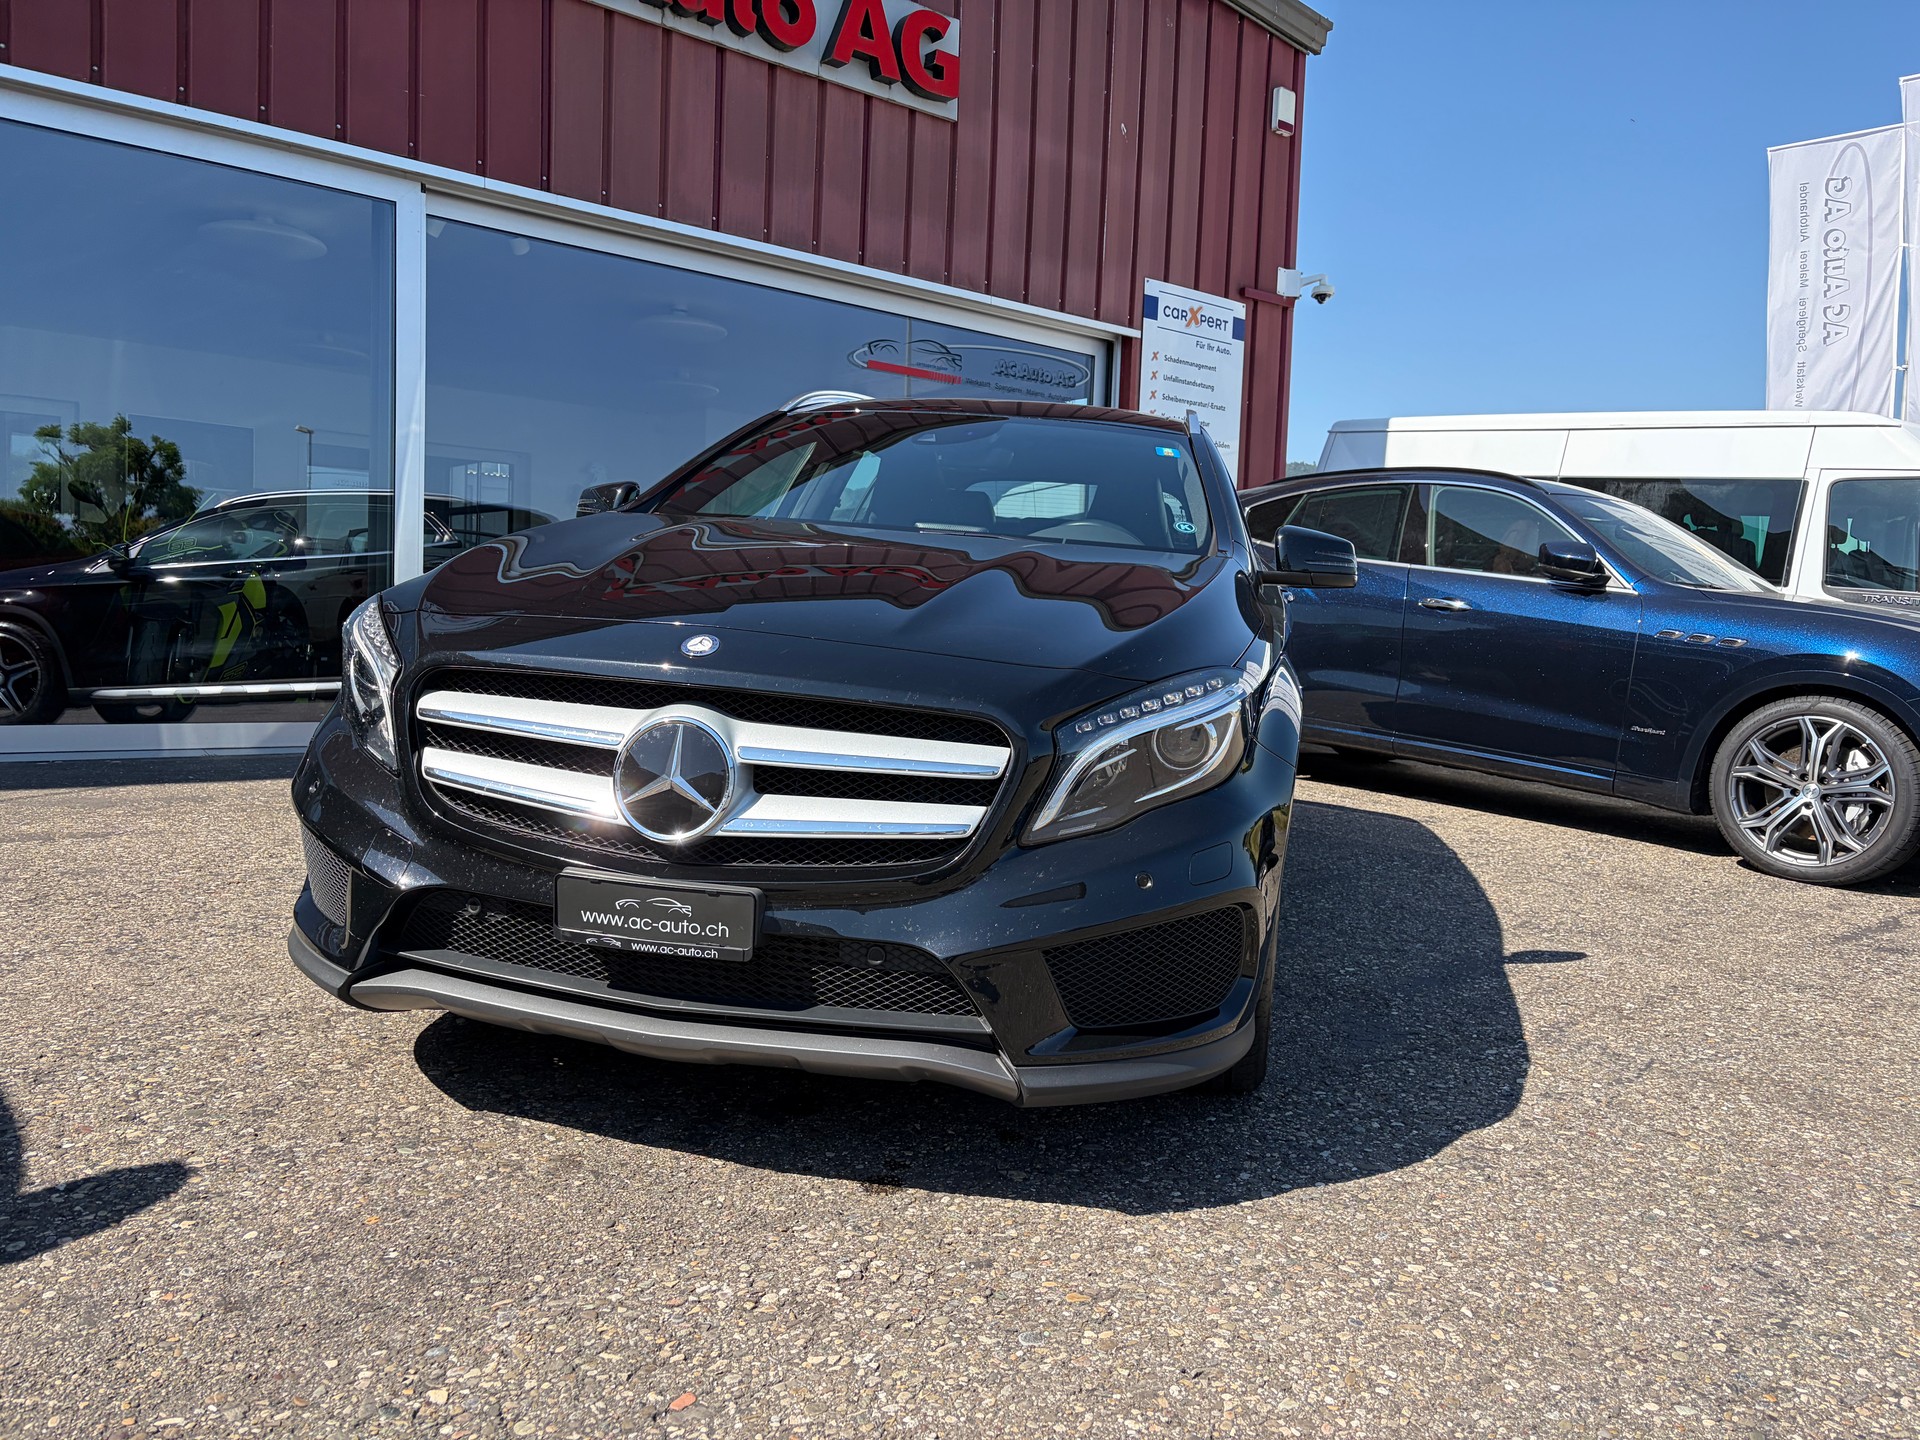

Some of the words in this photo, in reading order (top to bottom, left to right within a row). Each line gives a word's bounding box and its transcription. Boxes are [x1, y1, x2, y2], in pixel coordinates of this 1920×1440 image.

[821, 0, 960, 103] AG
[1195, 340, 1206, 349] Für
[1206, 343, 1215, 352] Ihr
[1216, 345, 1232, 356] Auto.
[1164, 354, 1217, 372] Schadenmanagement
[1018, 363, 1053, 384] Auto
[1163, 374, 1215, 392] Unfallinstandsetzung
[580, 910, 730, 938] www.ac-auto.ch
[631, 942, 719, 959] www.ac-auto.ch
